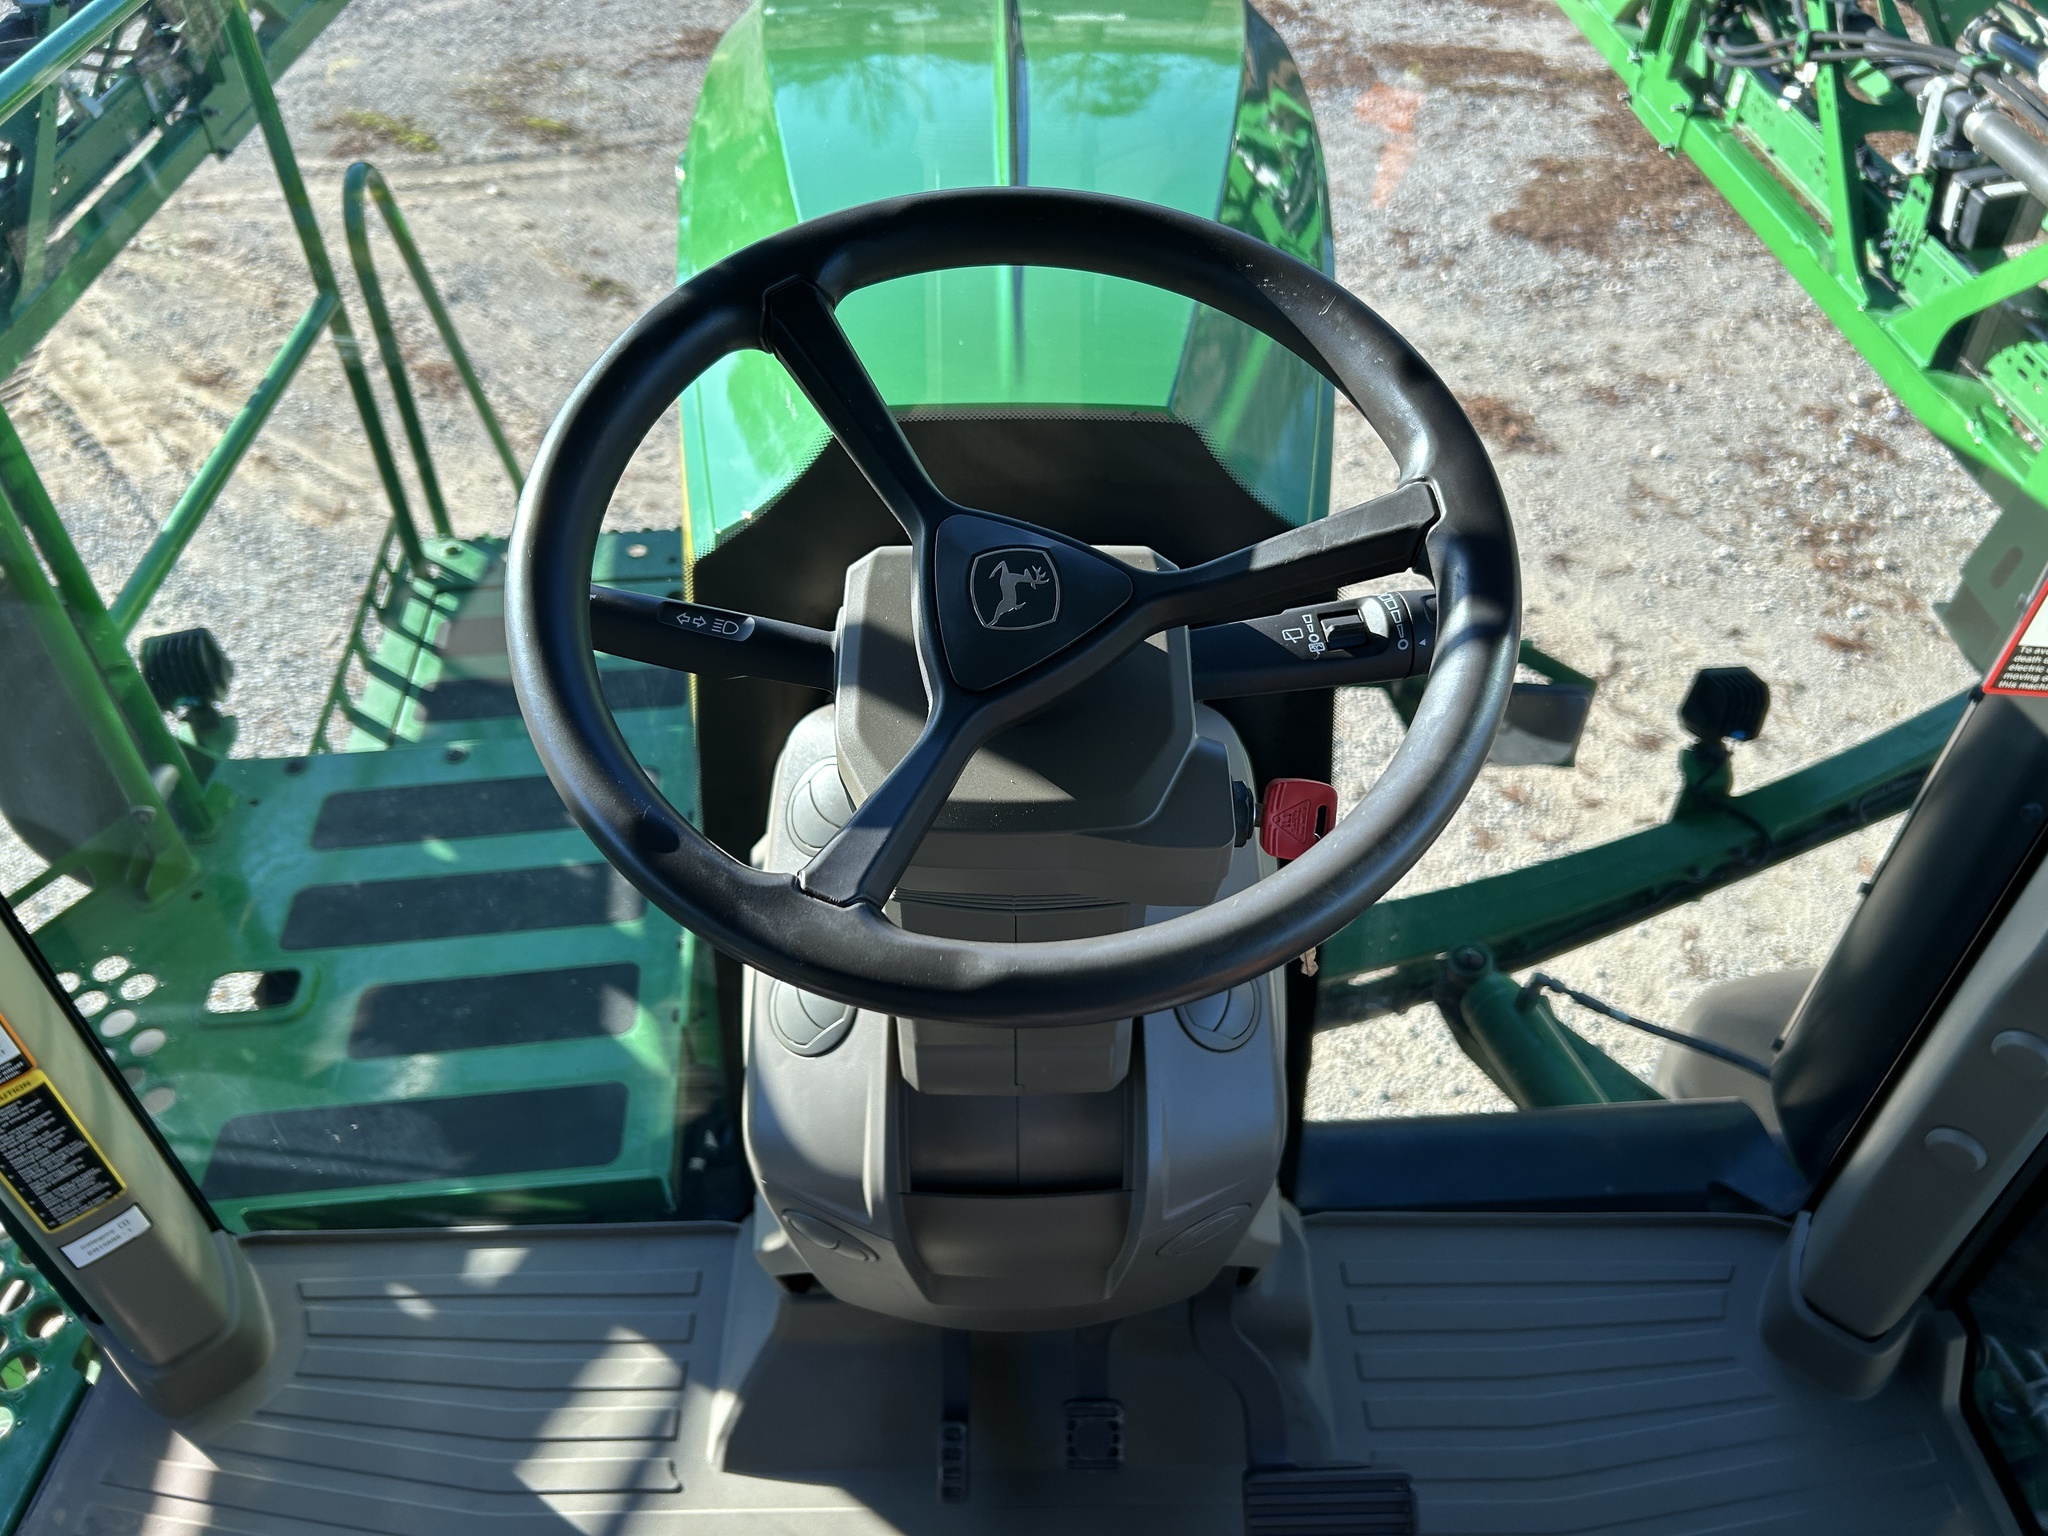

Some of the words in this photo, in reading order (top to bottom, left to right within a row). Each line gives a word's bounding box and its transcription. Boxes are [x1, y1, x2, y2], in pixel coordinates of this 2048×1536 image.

[2013, 654, 2042, 663] death
[2008, 663, 2046, 673] electric
[2003, 672, 2041, 683] moving
[1998, 680, 2017, 689] this
[0, 1080, 31, 1102] UTION
